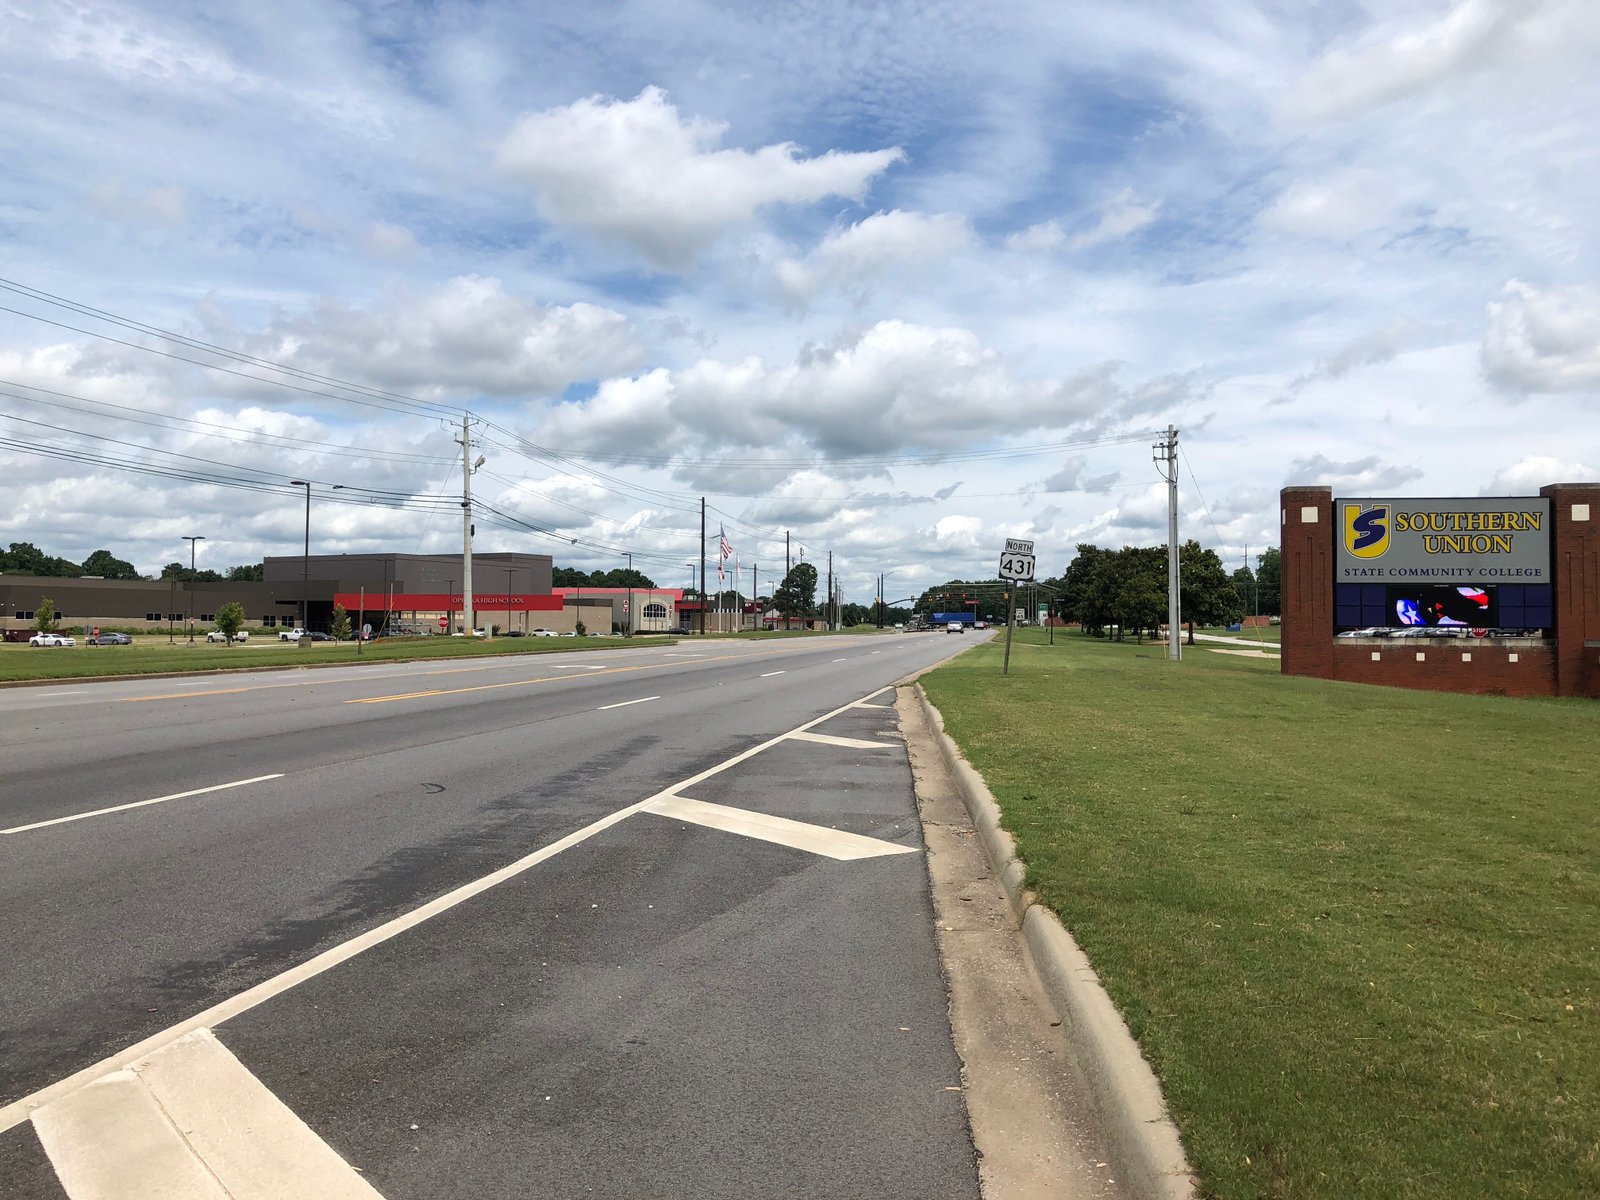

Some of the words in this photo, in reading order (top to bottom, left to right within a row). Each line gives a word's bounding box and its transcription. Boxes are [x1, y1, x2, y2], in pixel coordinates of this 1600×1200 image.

[1395, 511, 1543, 531] SOUTHERN
[1007, 541, 1032, 552] NORTH
[1423, 534, 1514, 554] UNION
[1002, 559, 1031, 575] 431
[1344, 567, 1385, 577] STATE
[1389, 567, 1474, 577] COMMUNITY
[1479, 567, 1542, 577] COLLEGE
